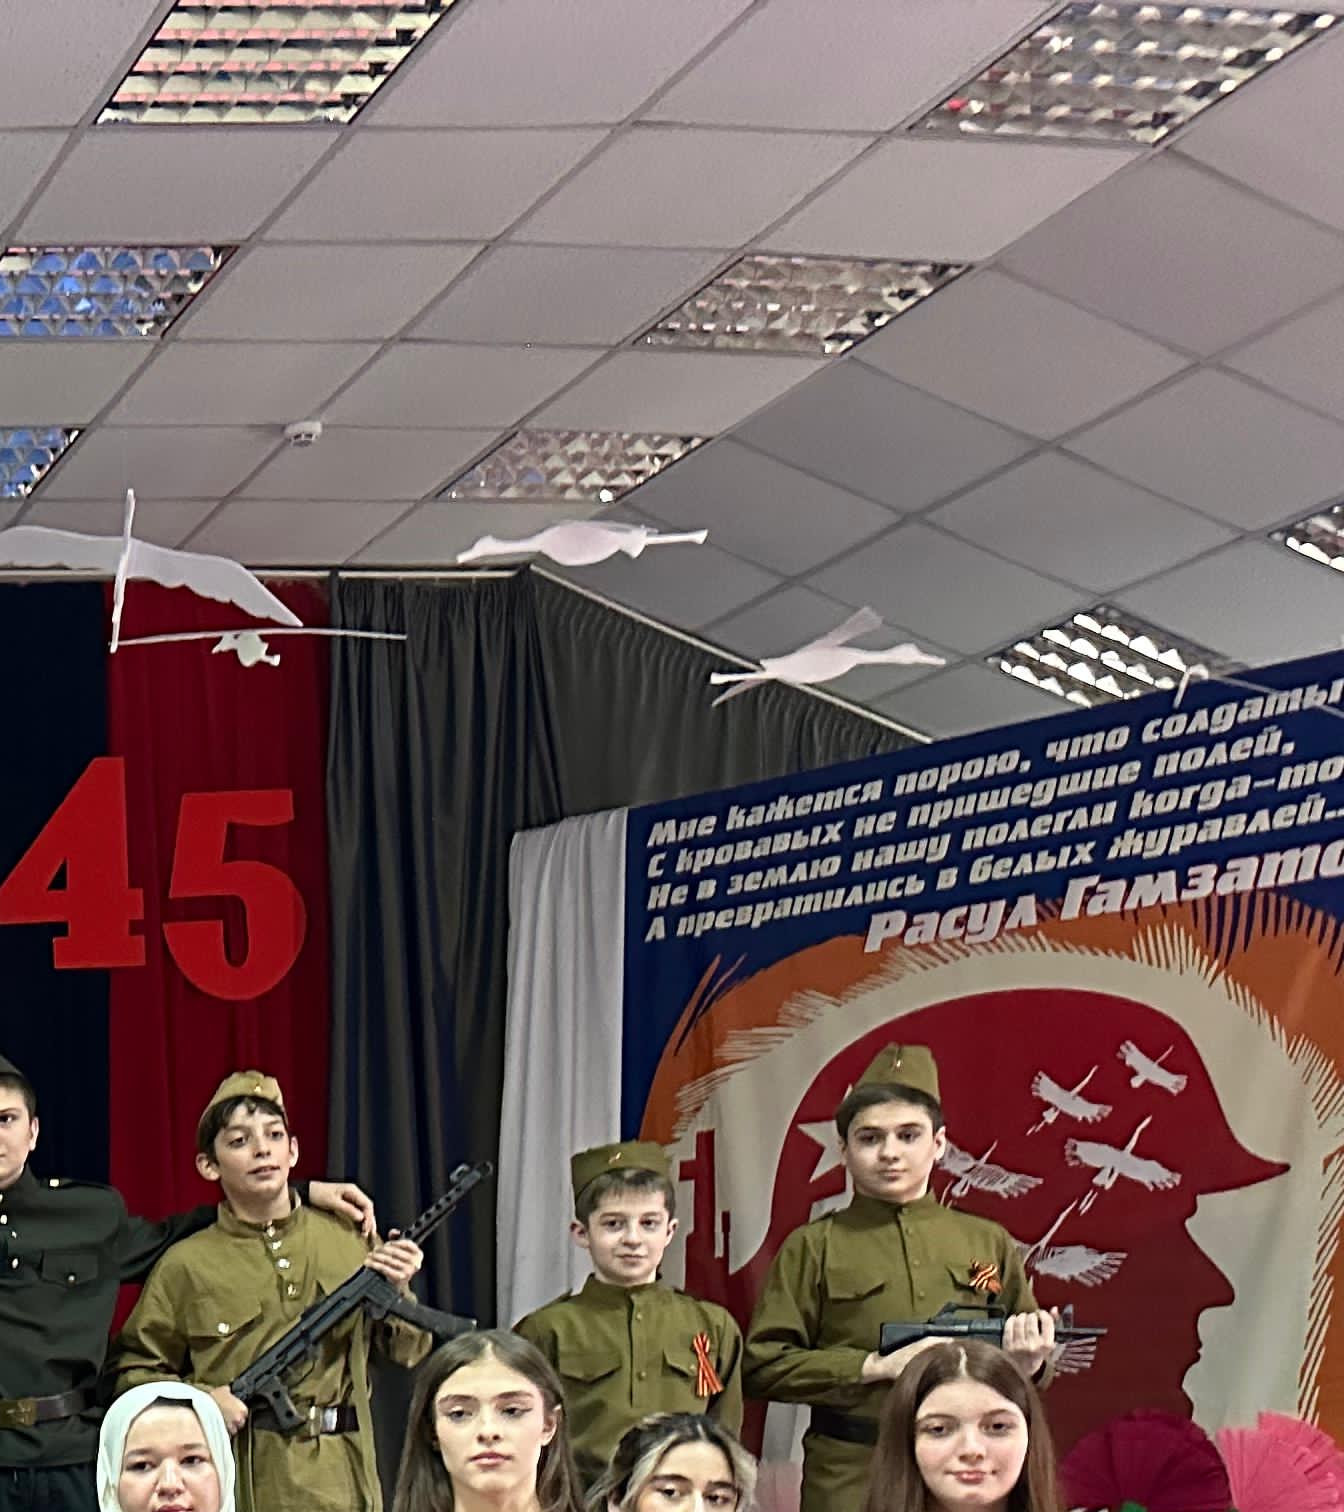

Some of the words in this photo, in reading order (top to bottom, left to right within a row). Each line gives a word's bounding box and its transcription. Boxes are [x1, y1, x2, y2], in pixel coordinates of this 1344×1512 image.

[647, 815, 717, 847] Мне
[725, 779, 883, 831] кажется
[893, 750, 1032, 797] порою,
[1046, 726, 1130, 762] что
[1141, 678, 1344, 744] солдаты
[647, 883, 689, 911] Не
[696, 879, 717, 902] в
[726, 855, 842, 895] землю
[851, 833, 952, 872] нашу
[962, 801, 1117, 850] полегли
[1128, 755, 1344, 820] когда-то
[675, 820, 845, 874] кровавых
[853, 810, 897, 839] не
[907, 760, 1142, 828] пришедшие
[1153, 725, 1296, 778] полей,
[644, 916, 665, 943] А
[676, 874, 926, 938] превратились
[936, 867, 959, 891] в
[969, 841, 1097, 885] белых
[864, 893, 1038, 953] Расул
